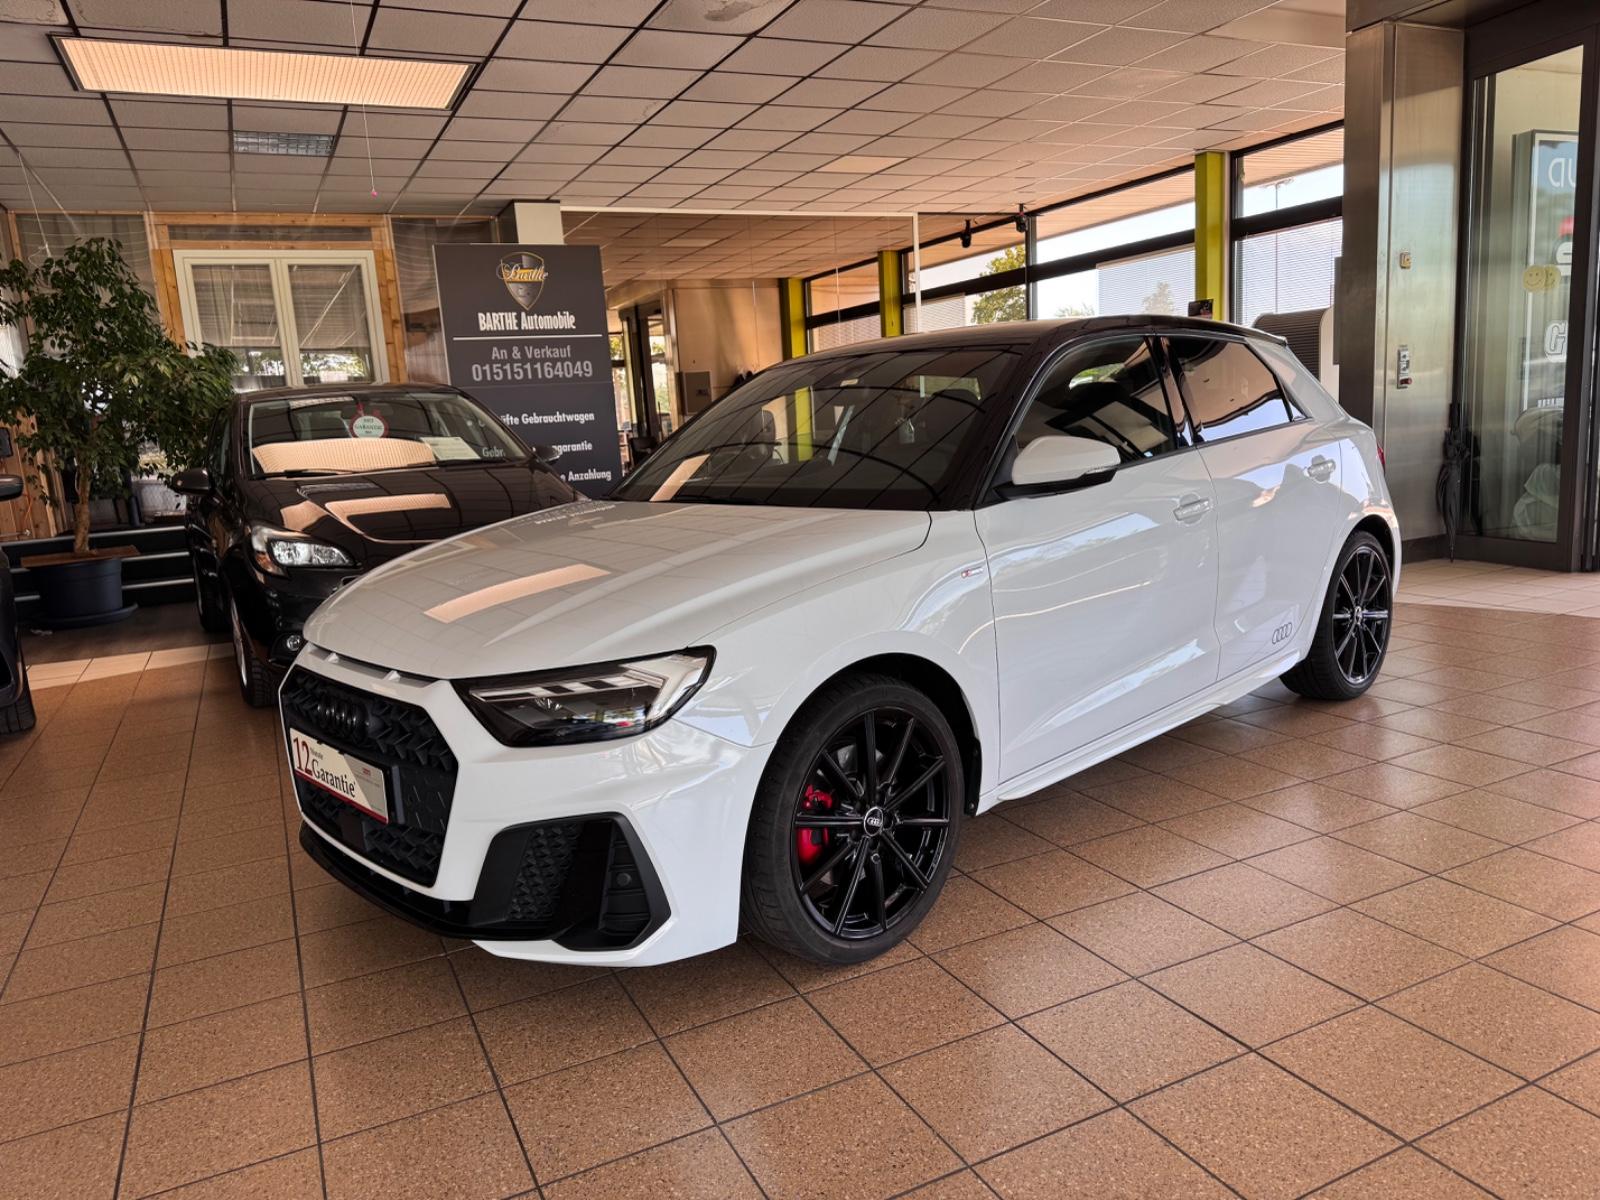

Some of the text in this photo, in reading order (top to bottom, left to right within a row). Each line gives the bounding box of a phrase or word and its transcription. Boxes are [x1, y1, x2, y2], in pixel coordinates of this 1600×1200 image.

[478, 311, 576, 331] BARTHE Automobile
[491, 345, 572, 360] An & Verkauf
[472, 361, 593, 381] 015151164049
[521, 412, 595, 425] Gebrauchtwagen
[568, 467, 612, 482] Anzahlung
[293, 737, 313, 776] 12
